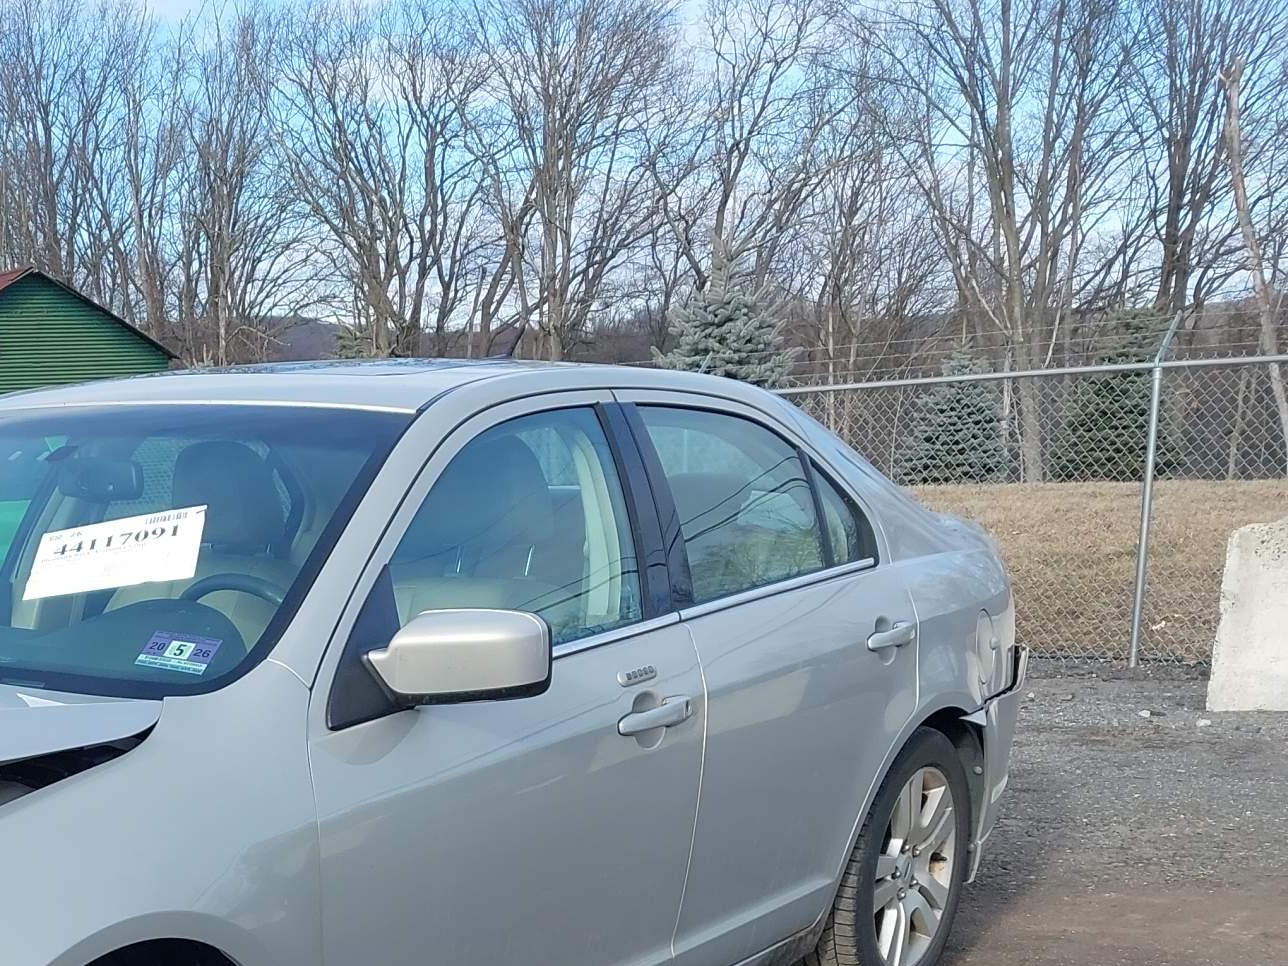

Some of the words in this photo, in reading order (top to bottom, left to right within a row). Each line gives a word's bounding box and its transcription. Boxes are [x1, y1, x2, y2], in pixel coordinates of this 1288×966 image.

[54, 525, 179, 555] 44117091
[149, 641, 166, 651] 20
[173, 643, 187, 656] 5
[193, 648, 212, 658] 26
